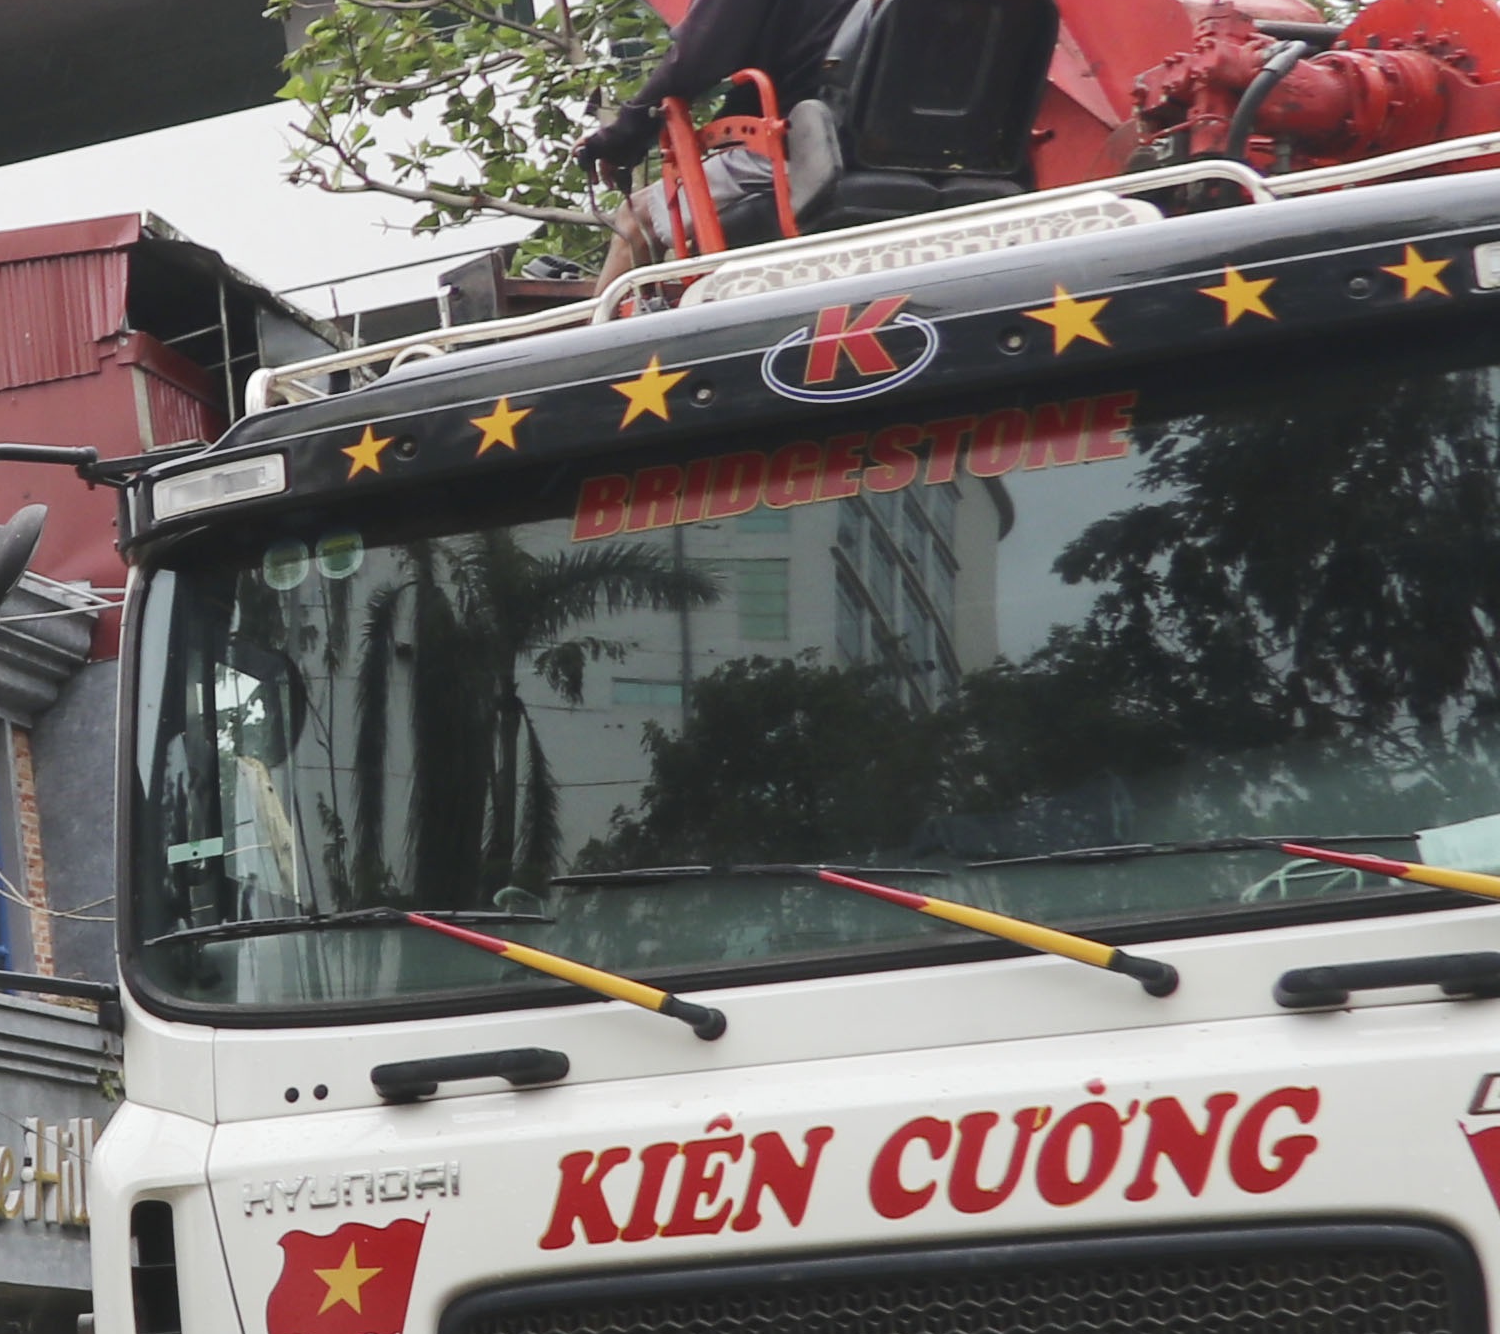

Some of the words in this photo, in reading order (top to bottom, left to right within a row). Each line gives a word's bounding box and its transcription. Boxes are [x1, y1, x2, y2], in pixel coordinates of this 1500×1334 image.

[571, 390, 1138, 542] BRIDGESTONE
[243, 1160, 460, 1217] HYUNDAI
[539, 1113, 834, 1250] KIÊN
